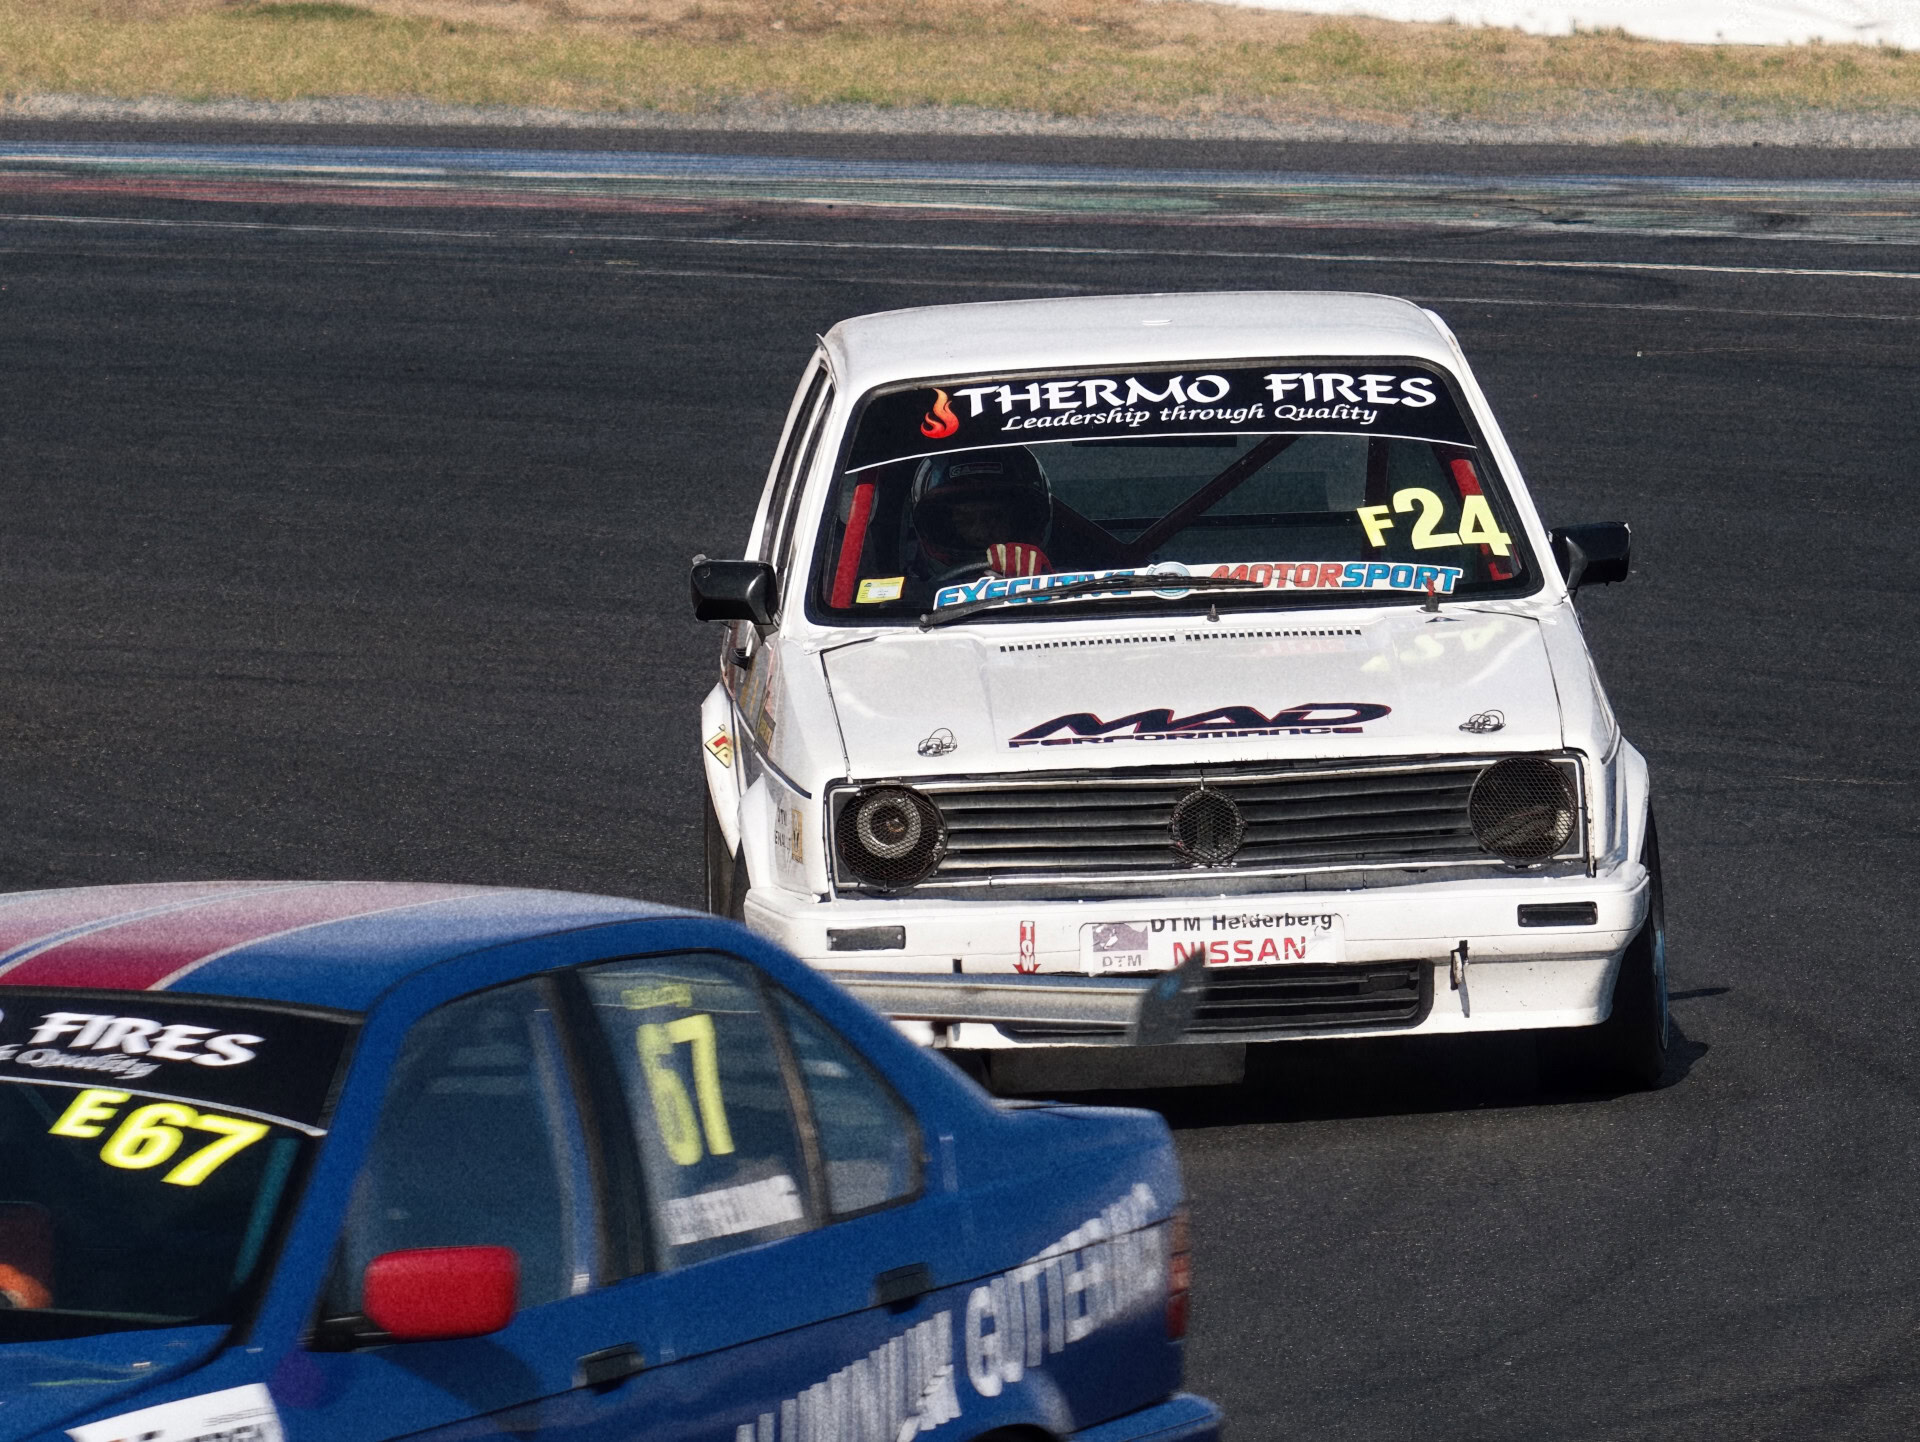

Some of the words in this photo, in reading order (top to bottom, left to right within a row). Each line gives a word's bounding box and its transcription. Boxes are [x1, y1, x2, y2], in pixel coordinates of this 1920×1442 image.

[953, 375, 1230, 417] THERMO
[1264, 372, 1437, 408] FIRES
[1001, 403, 1150, 431] Leadership
[1160, 402, 1265, 424] through
[1274, 403, 1378, 425] Quality
[1356, 487, 1512, 557] F24
[1209, 563, 1461, 592] MOTORSPORT
[1008, 702, 1393, 741] MAD
[1021, 921, 1034, 972] TOW
[1150, 916, 1202, 934] DTM
[1101, 955, 1142, 968] DTM
[27, 1012, 266, 1067] FIRES
[636, 1014, 735, 1166] 67
[48, 1087, 271, 1187] E67
